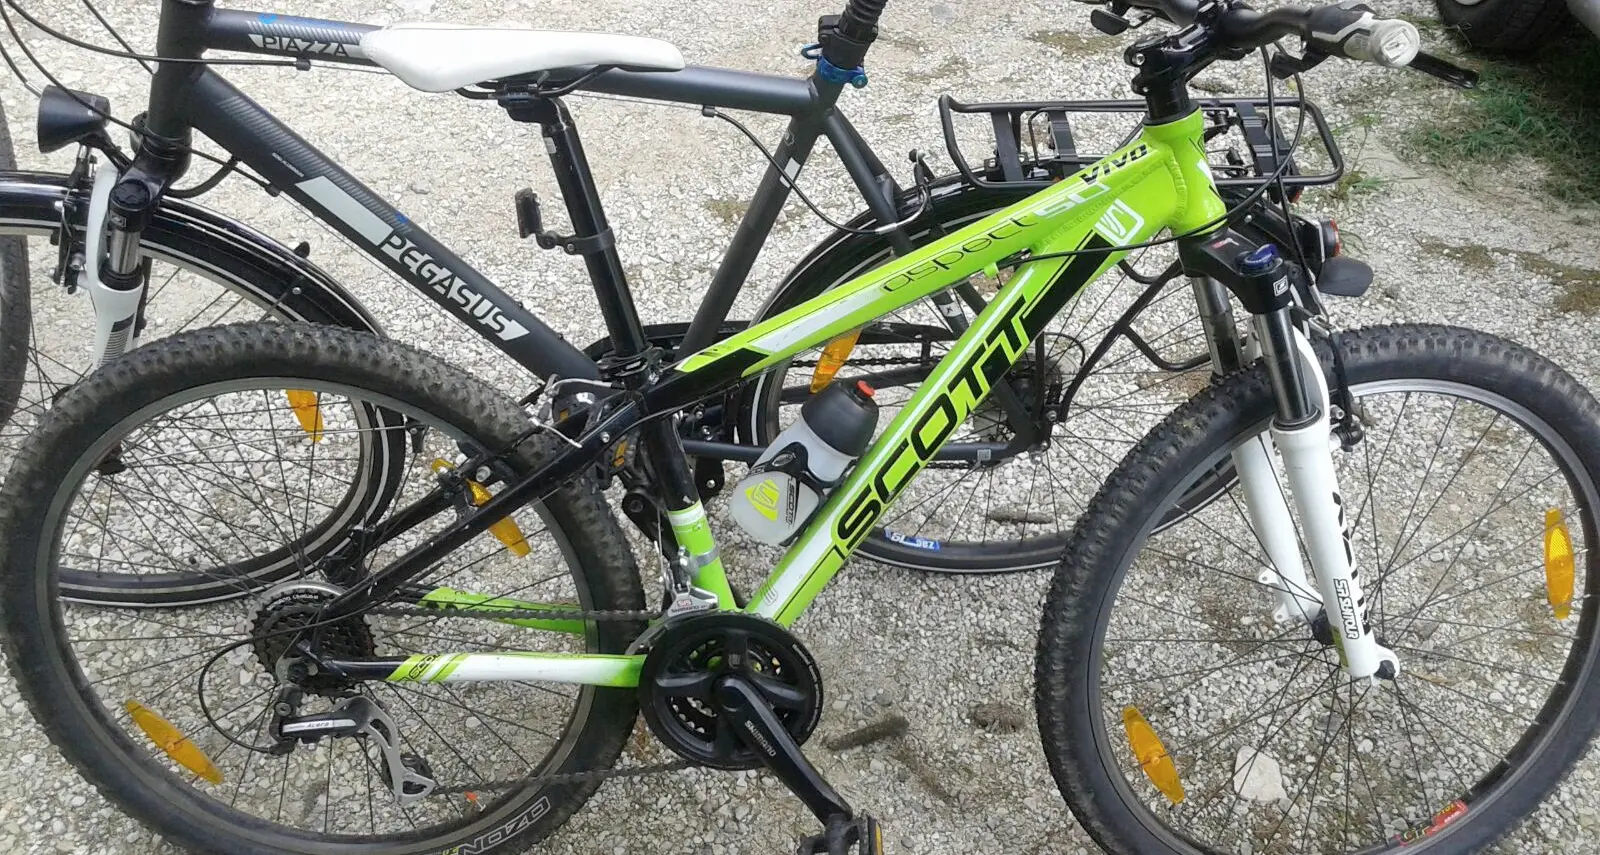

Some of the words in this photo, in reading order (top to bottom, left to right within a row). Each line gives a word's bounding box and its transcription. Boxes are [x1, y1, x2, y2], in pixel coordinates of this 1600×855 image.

[262, 36, 350, 58] PIAZZA
[380, 233, 507, 335] PEGASUS
[883, 216, 1038, 293] aspect
[837, 293, 1029, 550] SCOTT
[1337, 596, 1360, 640] SUNTOUR
